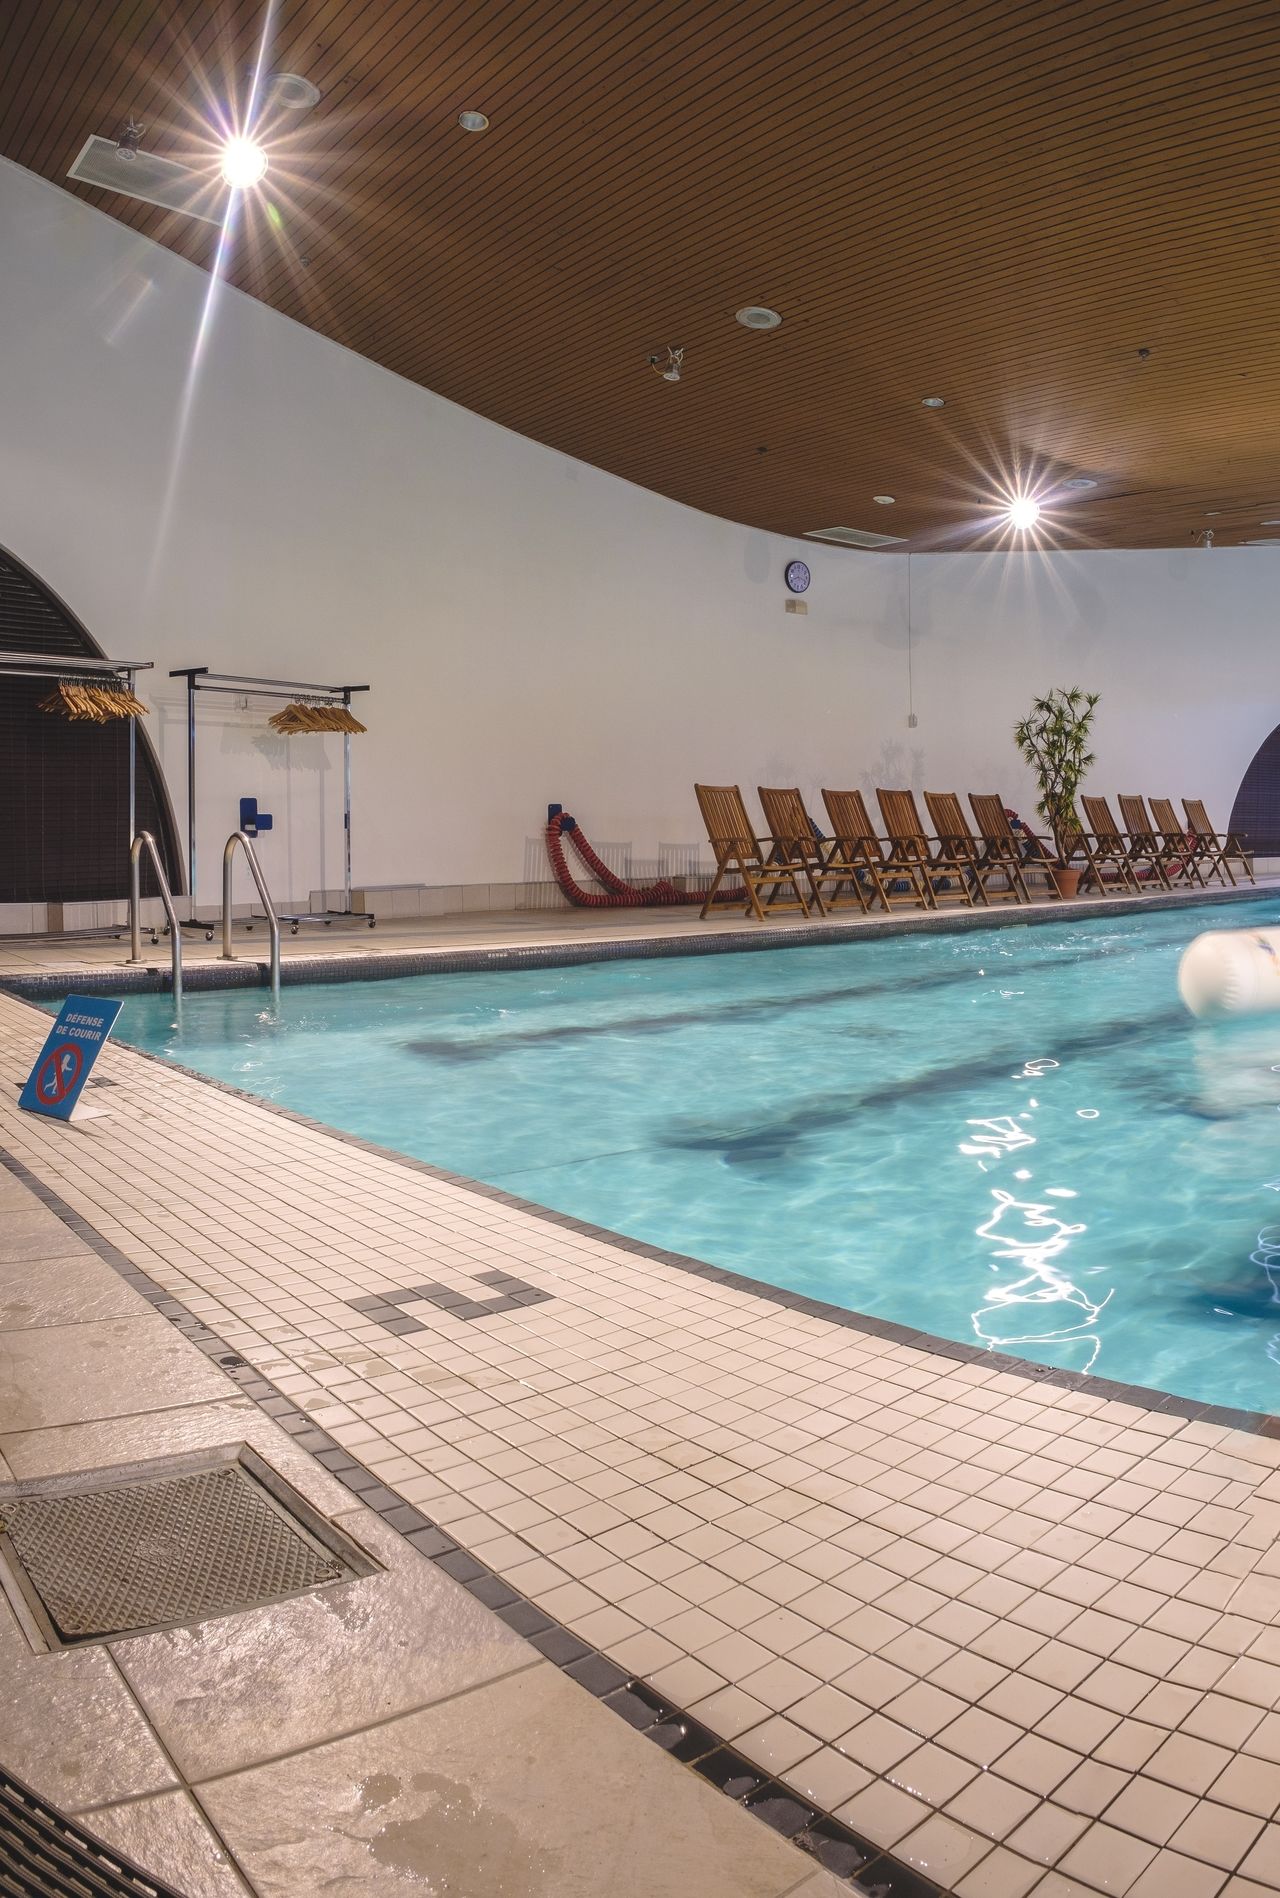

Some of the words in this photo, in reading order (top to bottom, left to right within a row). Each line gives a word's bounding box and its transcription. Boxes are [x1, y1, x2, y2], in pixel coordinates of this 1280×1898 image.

[66, 1013, 104, 1027] DÉFENSE
[56, 1025, 68, 1035] DE
[69, 1028, 102, 1041] COURIR
